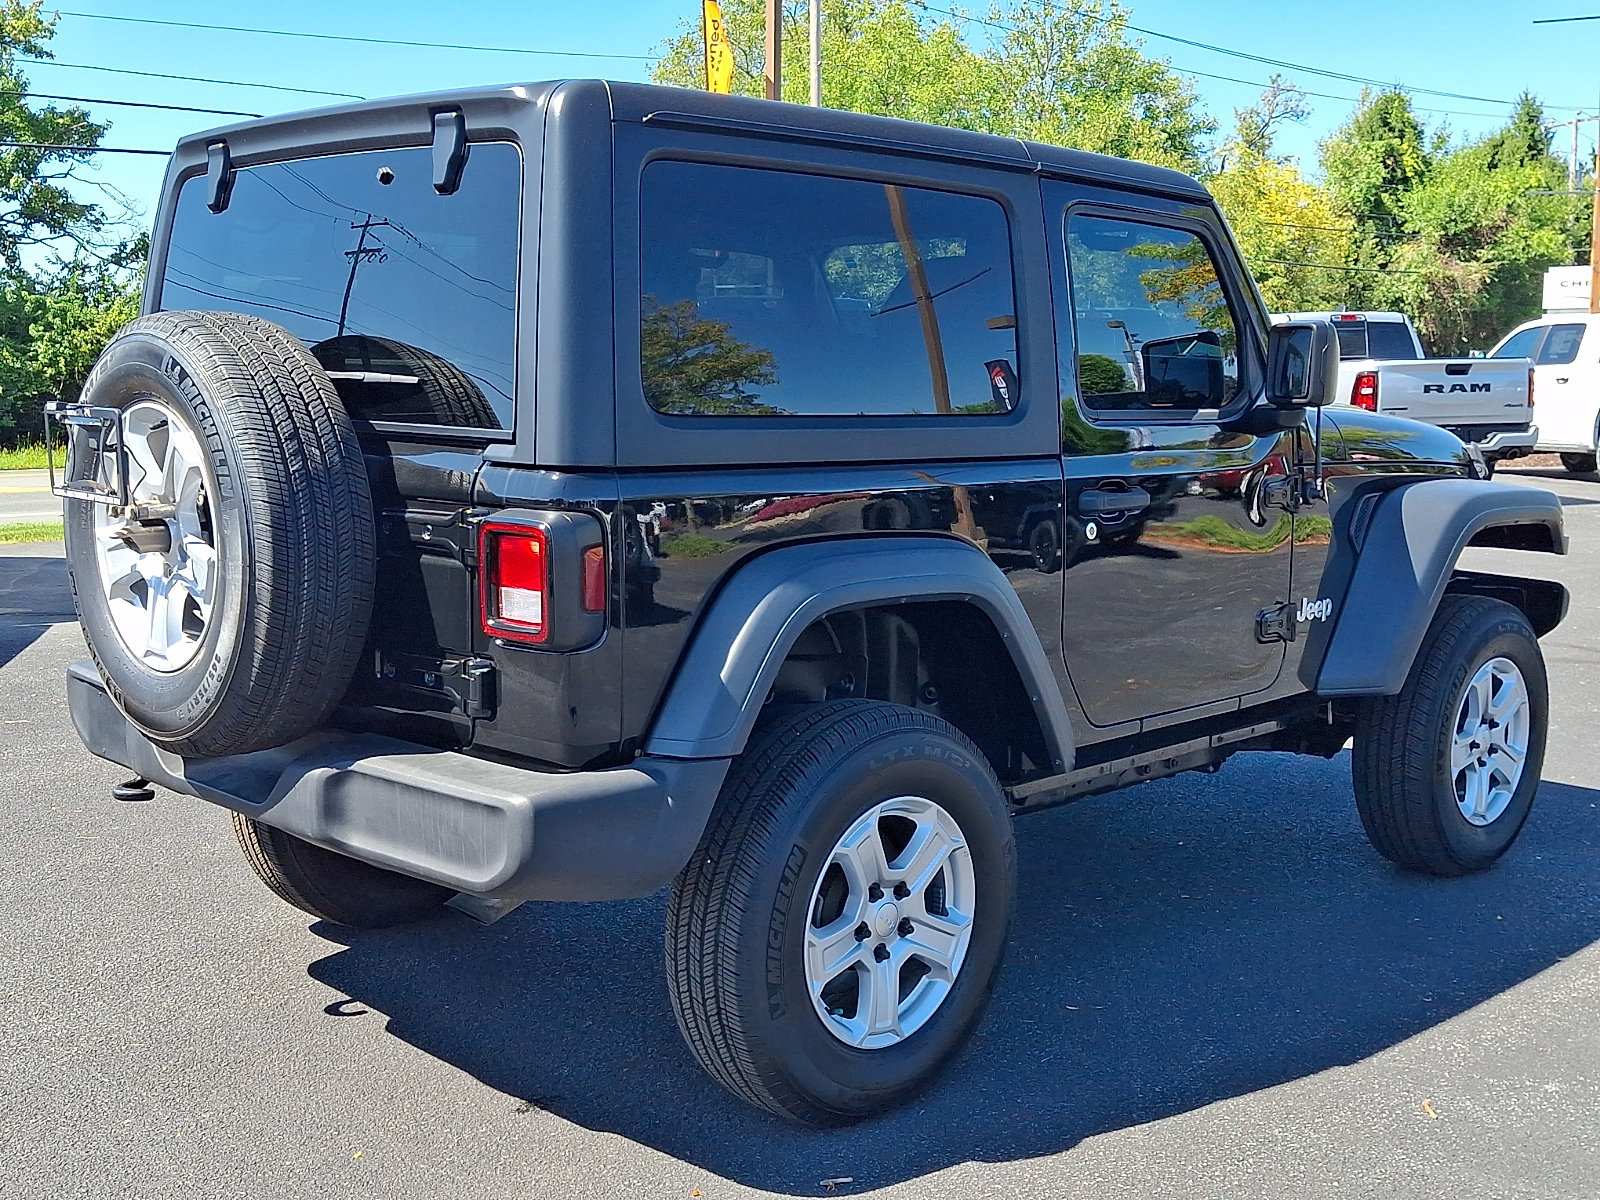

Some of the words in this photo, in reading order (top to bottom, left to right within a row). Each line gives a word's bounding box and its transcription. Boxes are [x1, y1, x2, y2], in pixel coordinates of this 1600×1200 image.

[1423, 383, 1491, 393] RAM
[180, 378, 234, 498] MICHELIN
[1297, 598, 1333, 622] Jeep
[767, 845, 805, 985] MICHELIN
